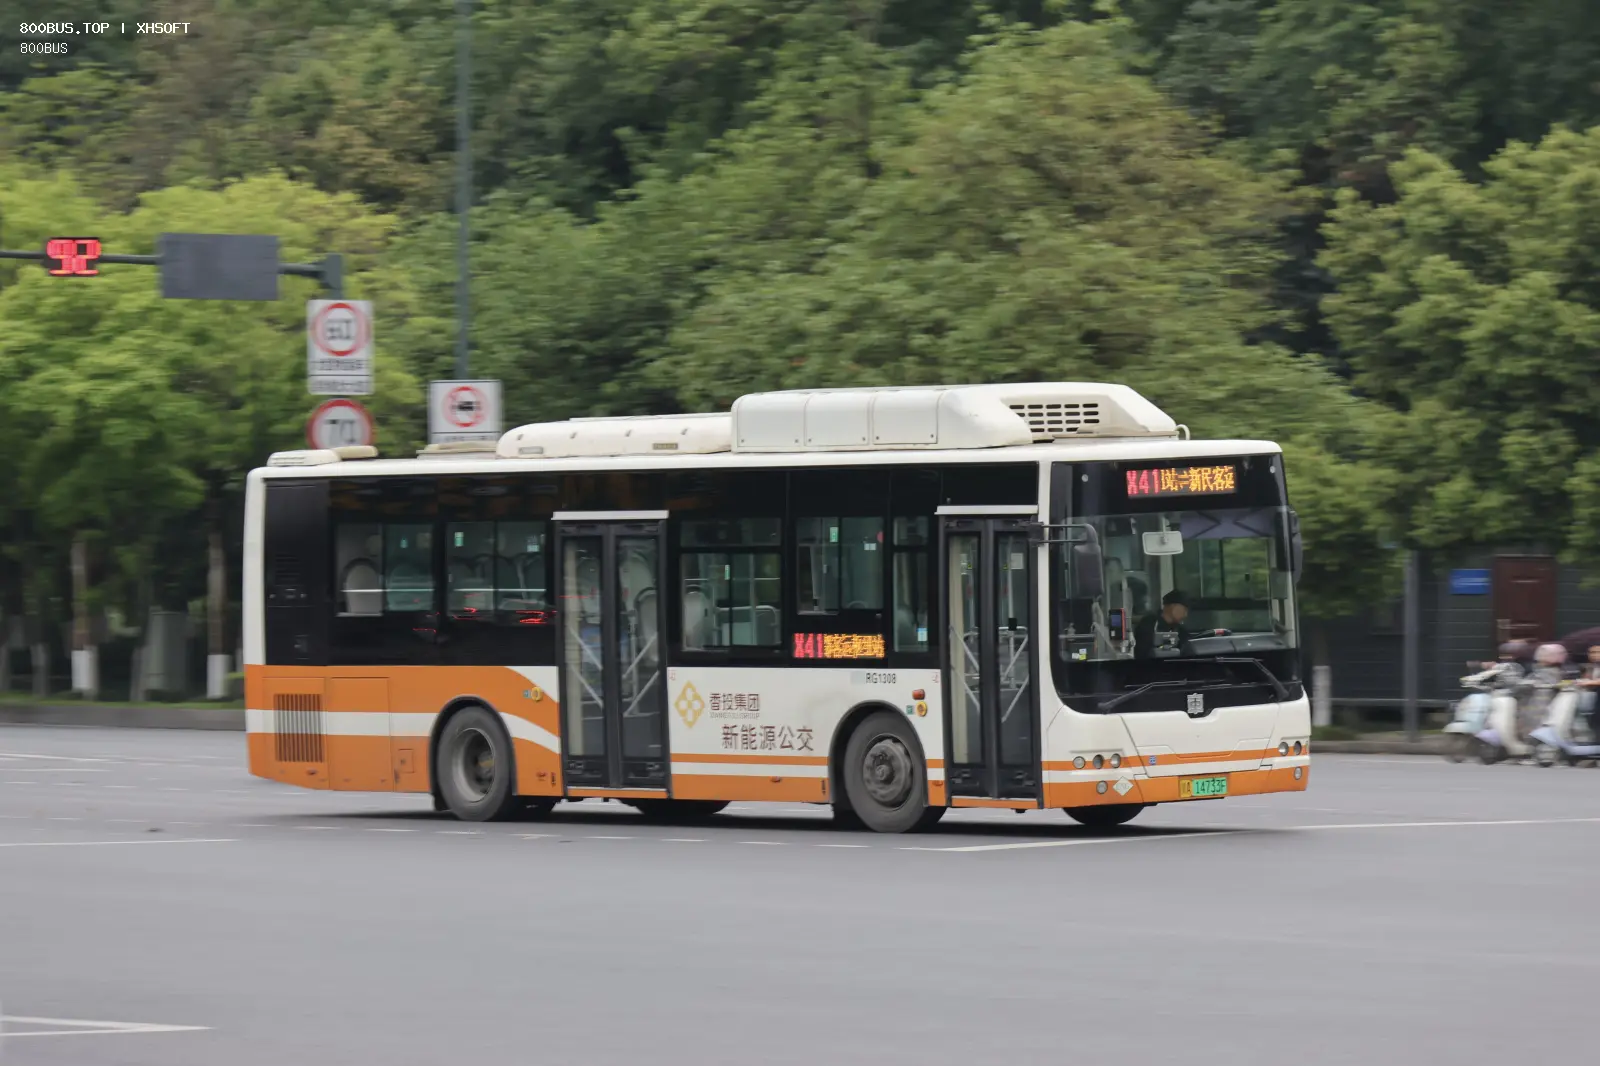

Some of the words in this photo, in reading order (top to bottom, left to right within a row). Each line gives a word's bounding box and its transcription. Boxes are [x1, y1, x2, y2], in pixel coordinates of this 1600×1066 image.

[794, 633, 823, 658] X41
[865, 672, 896, 684] RG1308
[709, 692, 760, 711] 香投集团
[721, 723, 814, 751] 新能源公交
